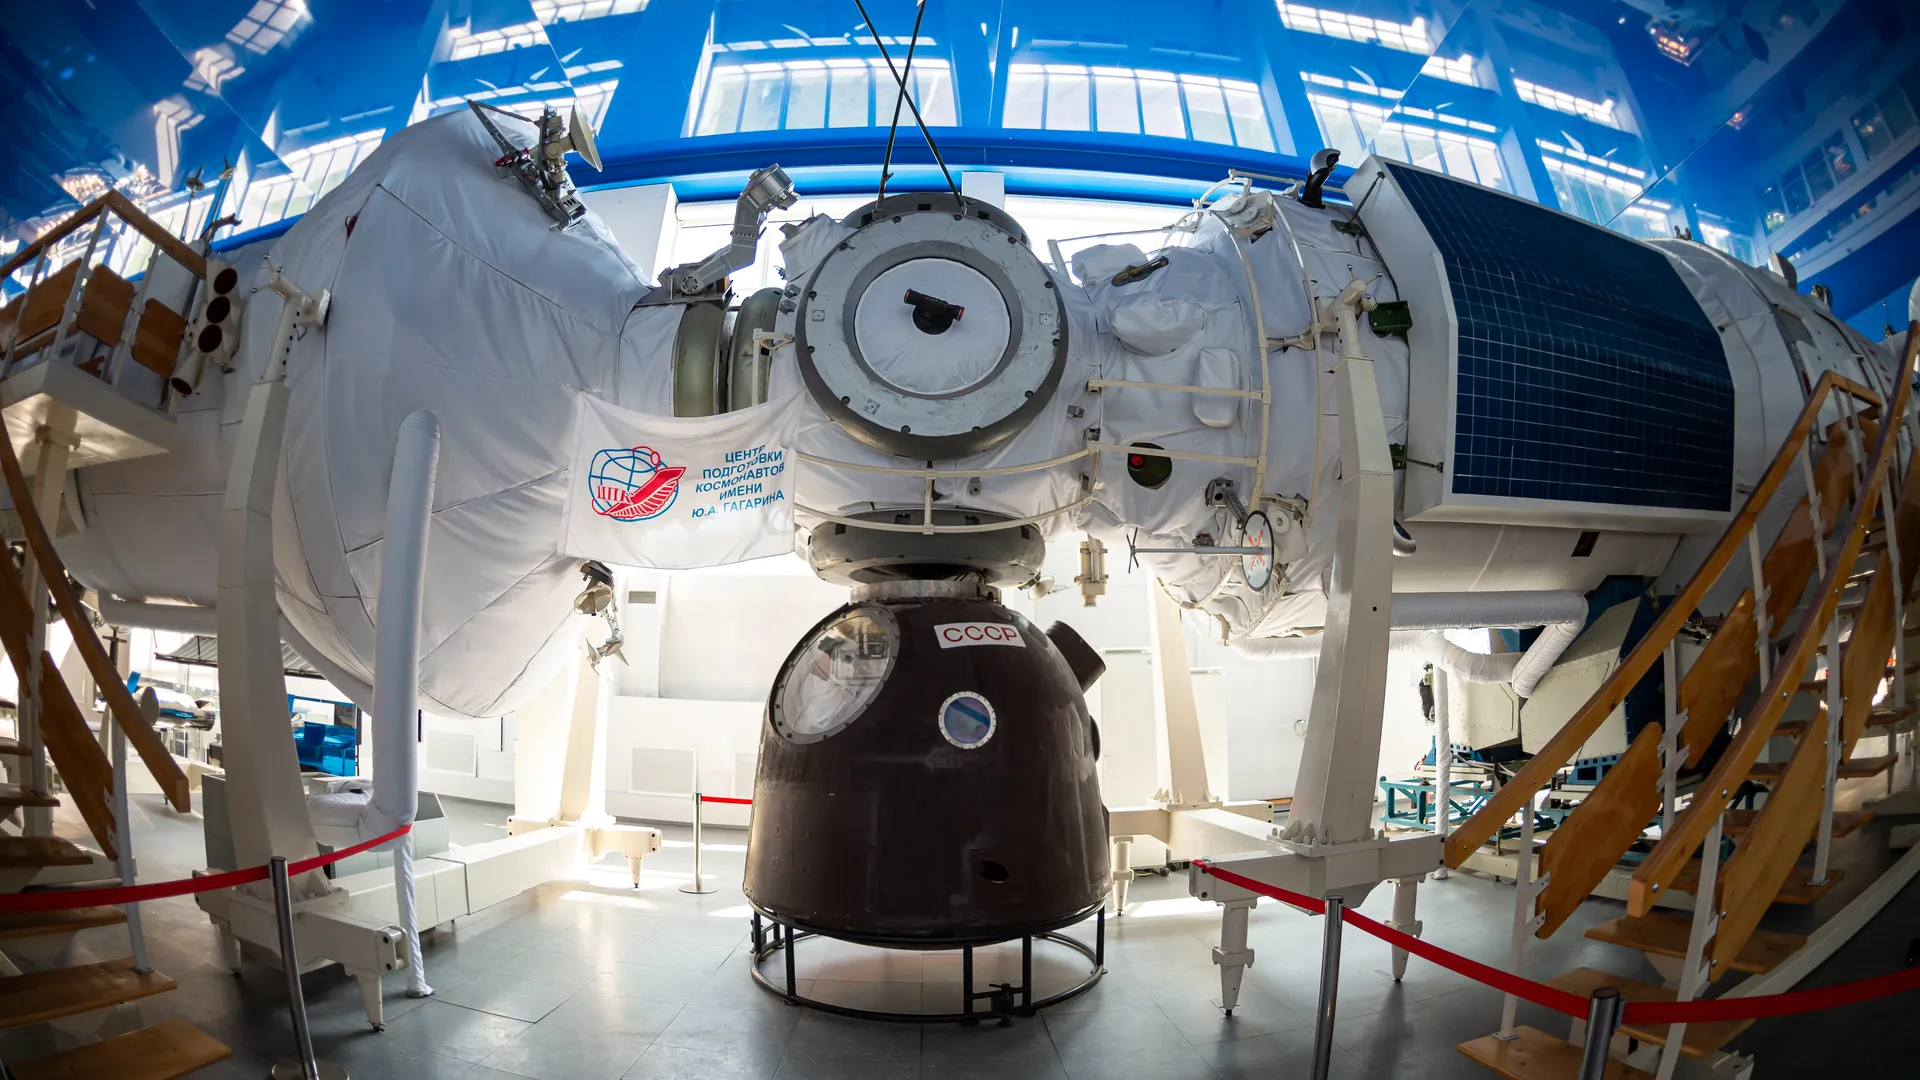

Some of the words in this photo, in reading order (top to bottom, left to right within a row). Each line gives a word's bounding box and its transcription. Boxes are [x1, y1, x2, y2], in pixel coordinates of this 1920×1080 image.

[702, 450, 783, 480] ПОДГОТОВКИ
[725, 445, 766, 464] ЦЕНТР
[695, 462, 785, 493] КОСМОНАВТОВ
[691, 505, 719, 518] Ю.А.
[723, 489, 785, 512] ГАГАРИНА
[719, 482, 763, 501] ИМЕНИ
[943, 625, 1017, 643] СССР
